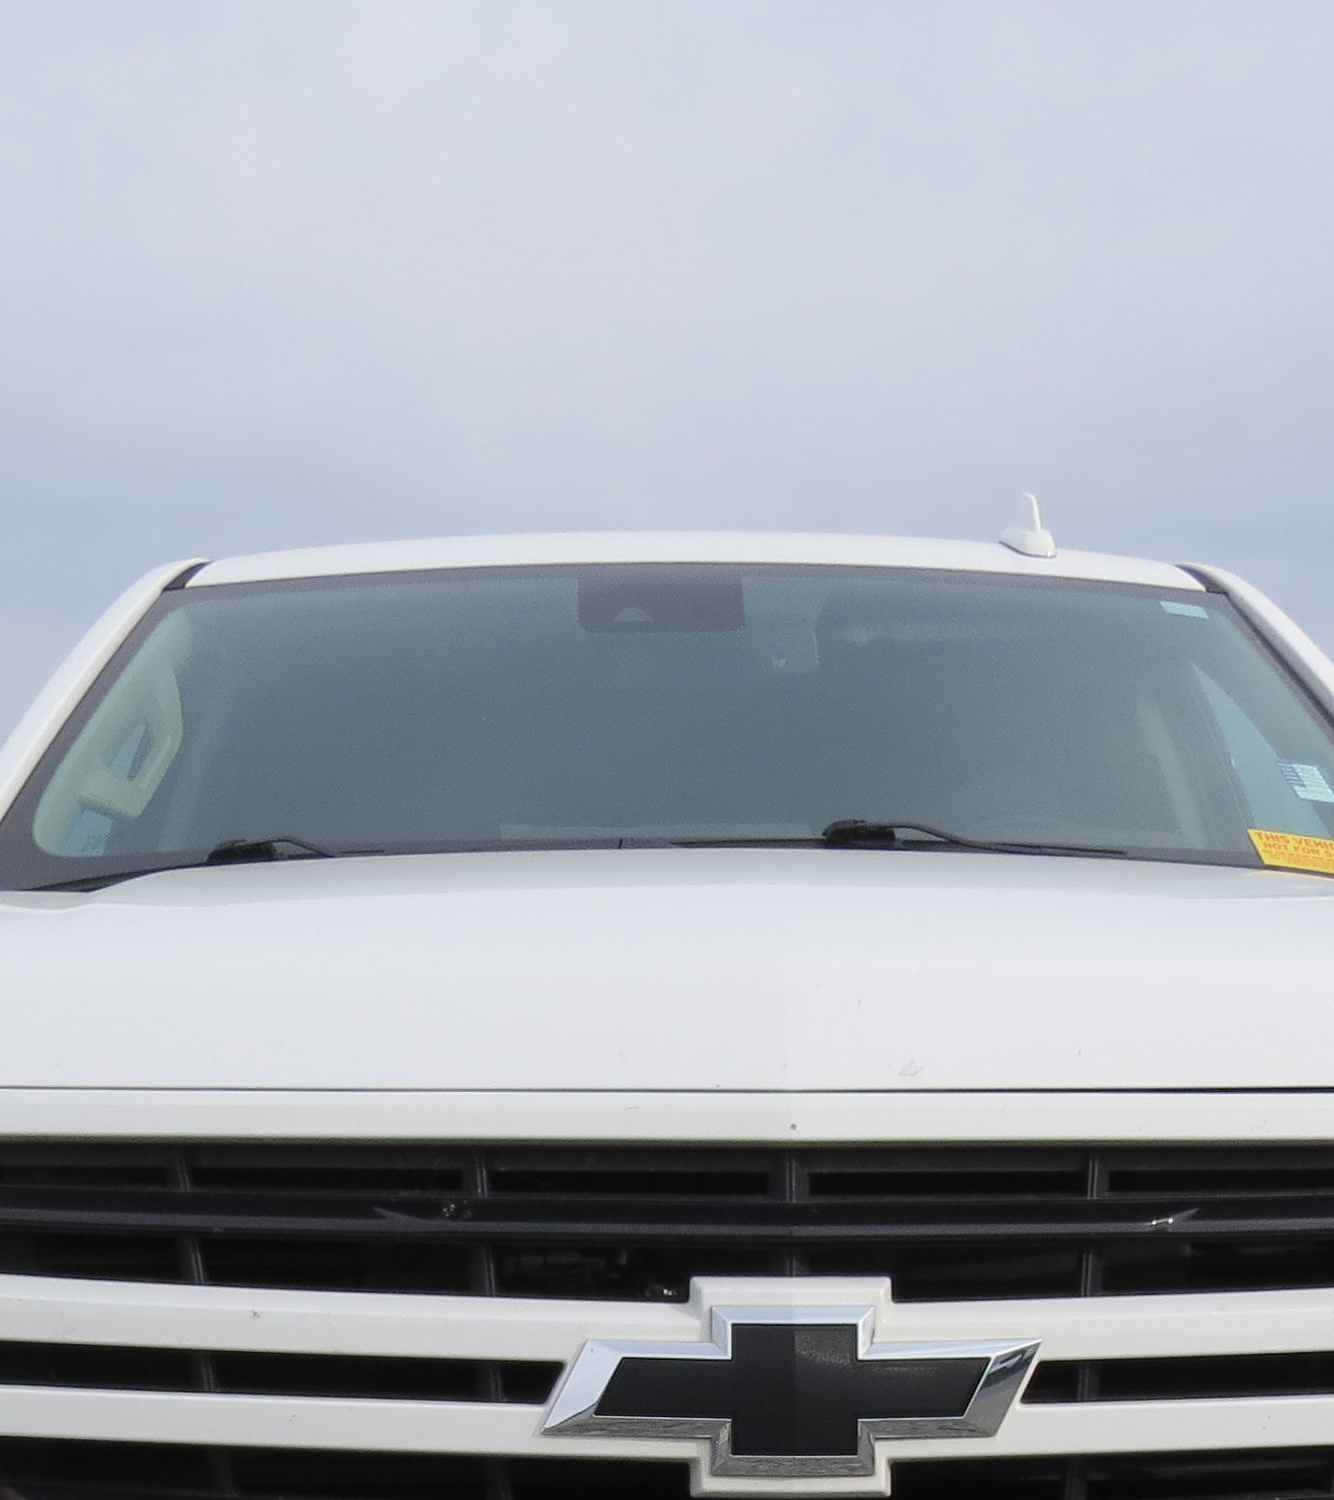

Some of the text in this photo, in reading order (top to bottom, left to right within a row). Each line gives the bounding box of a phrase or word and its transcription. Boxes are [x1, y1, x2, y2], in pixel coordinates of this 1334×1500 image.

[1255, 831, 1290, 844] THIS
[1263, 842, 1288, 851] NOT
[1293, 846, 1320, 855] FOR
